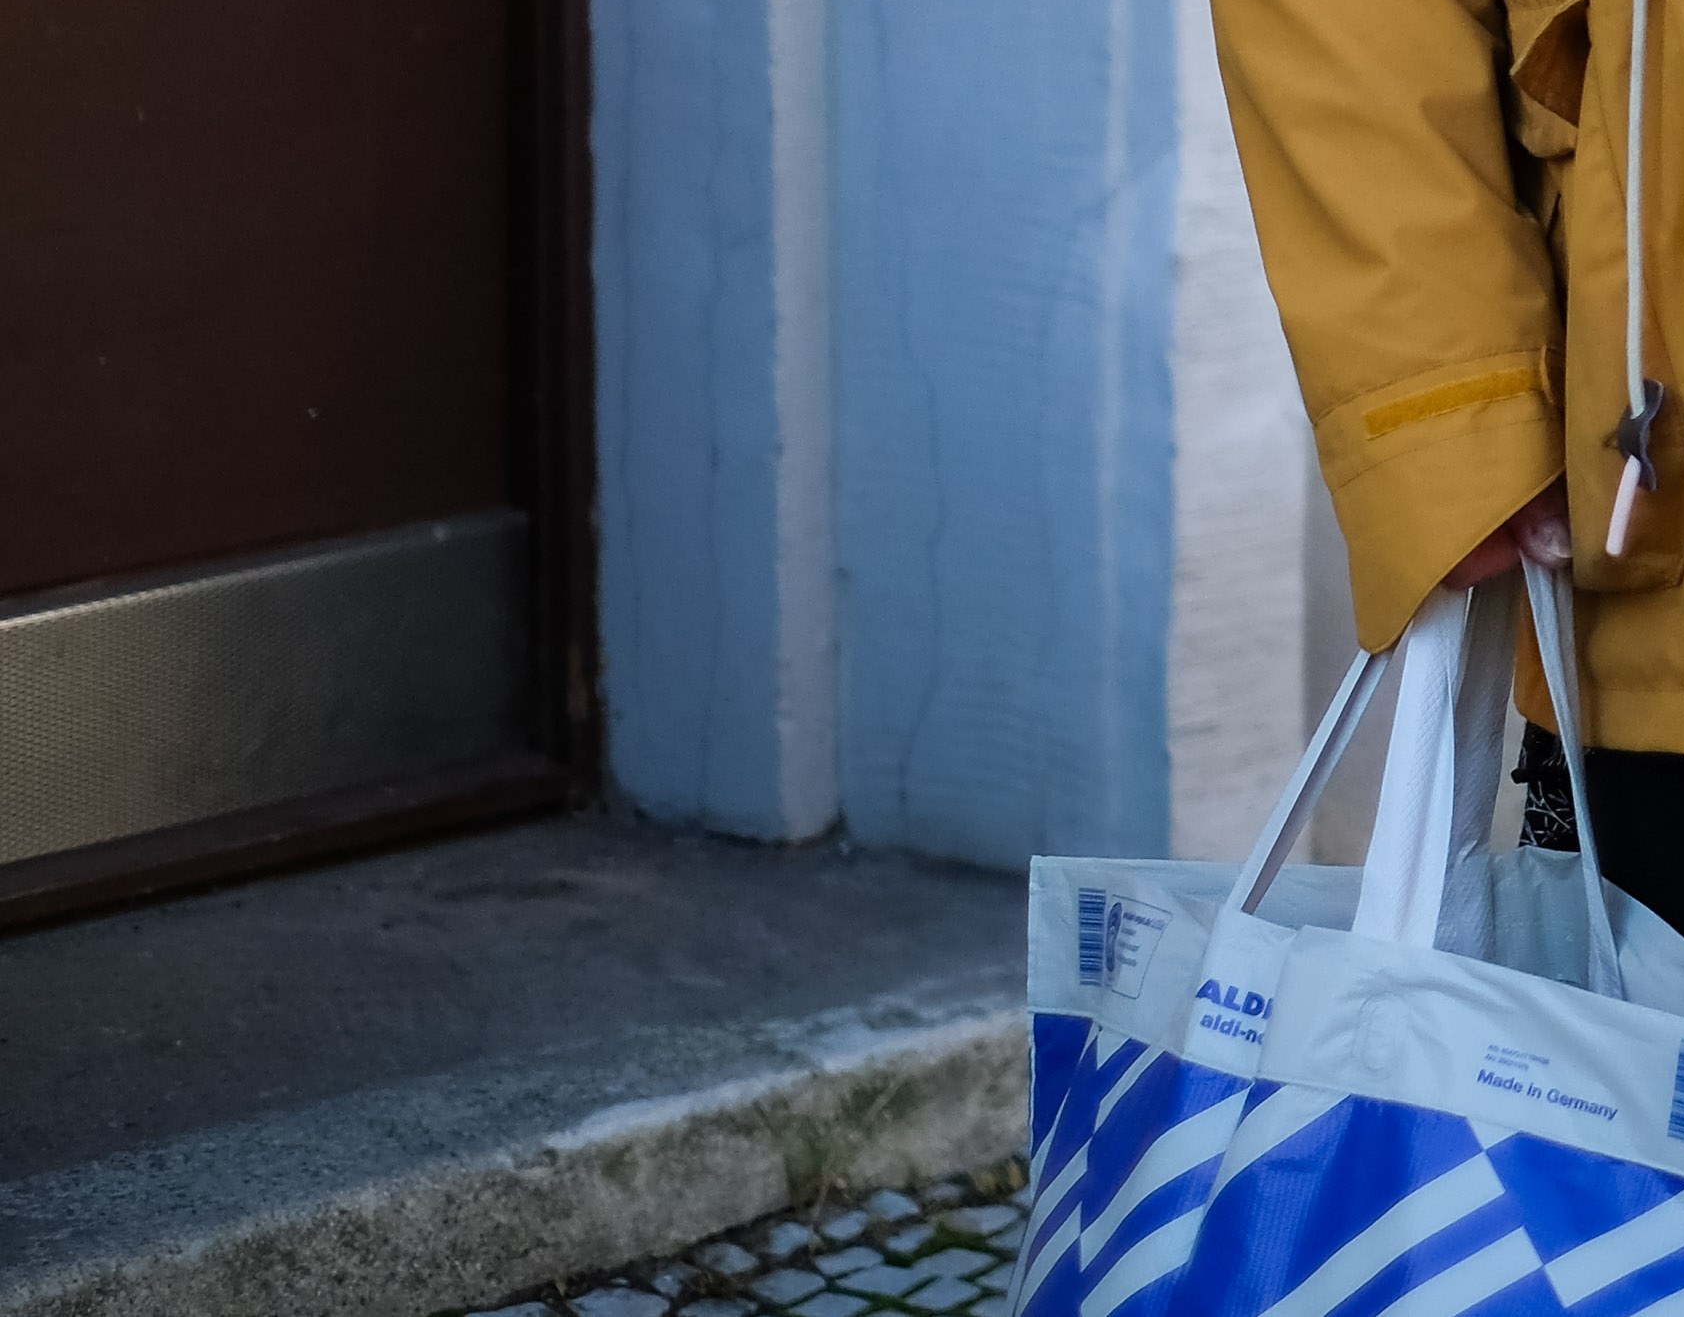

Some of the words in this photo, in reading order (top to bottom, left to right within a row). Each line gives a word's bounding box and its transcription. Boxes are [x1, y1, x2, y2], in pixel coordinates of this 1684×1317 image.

[1195, 978, 1273, 1020] ALDI
[1477, 1069, 1523, 1093] Made
[1527, 1082, 1542, 1099] in
[1547, 1088, 1618, 1121] Germany
